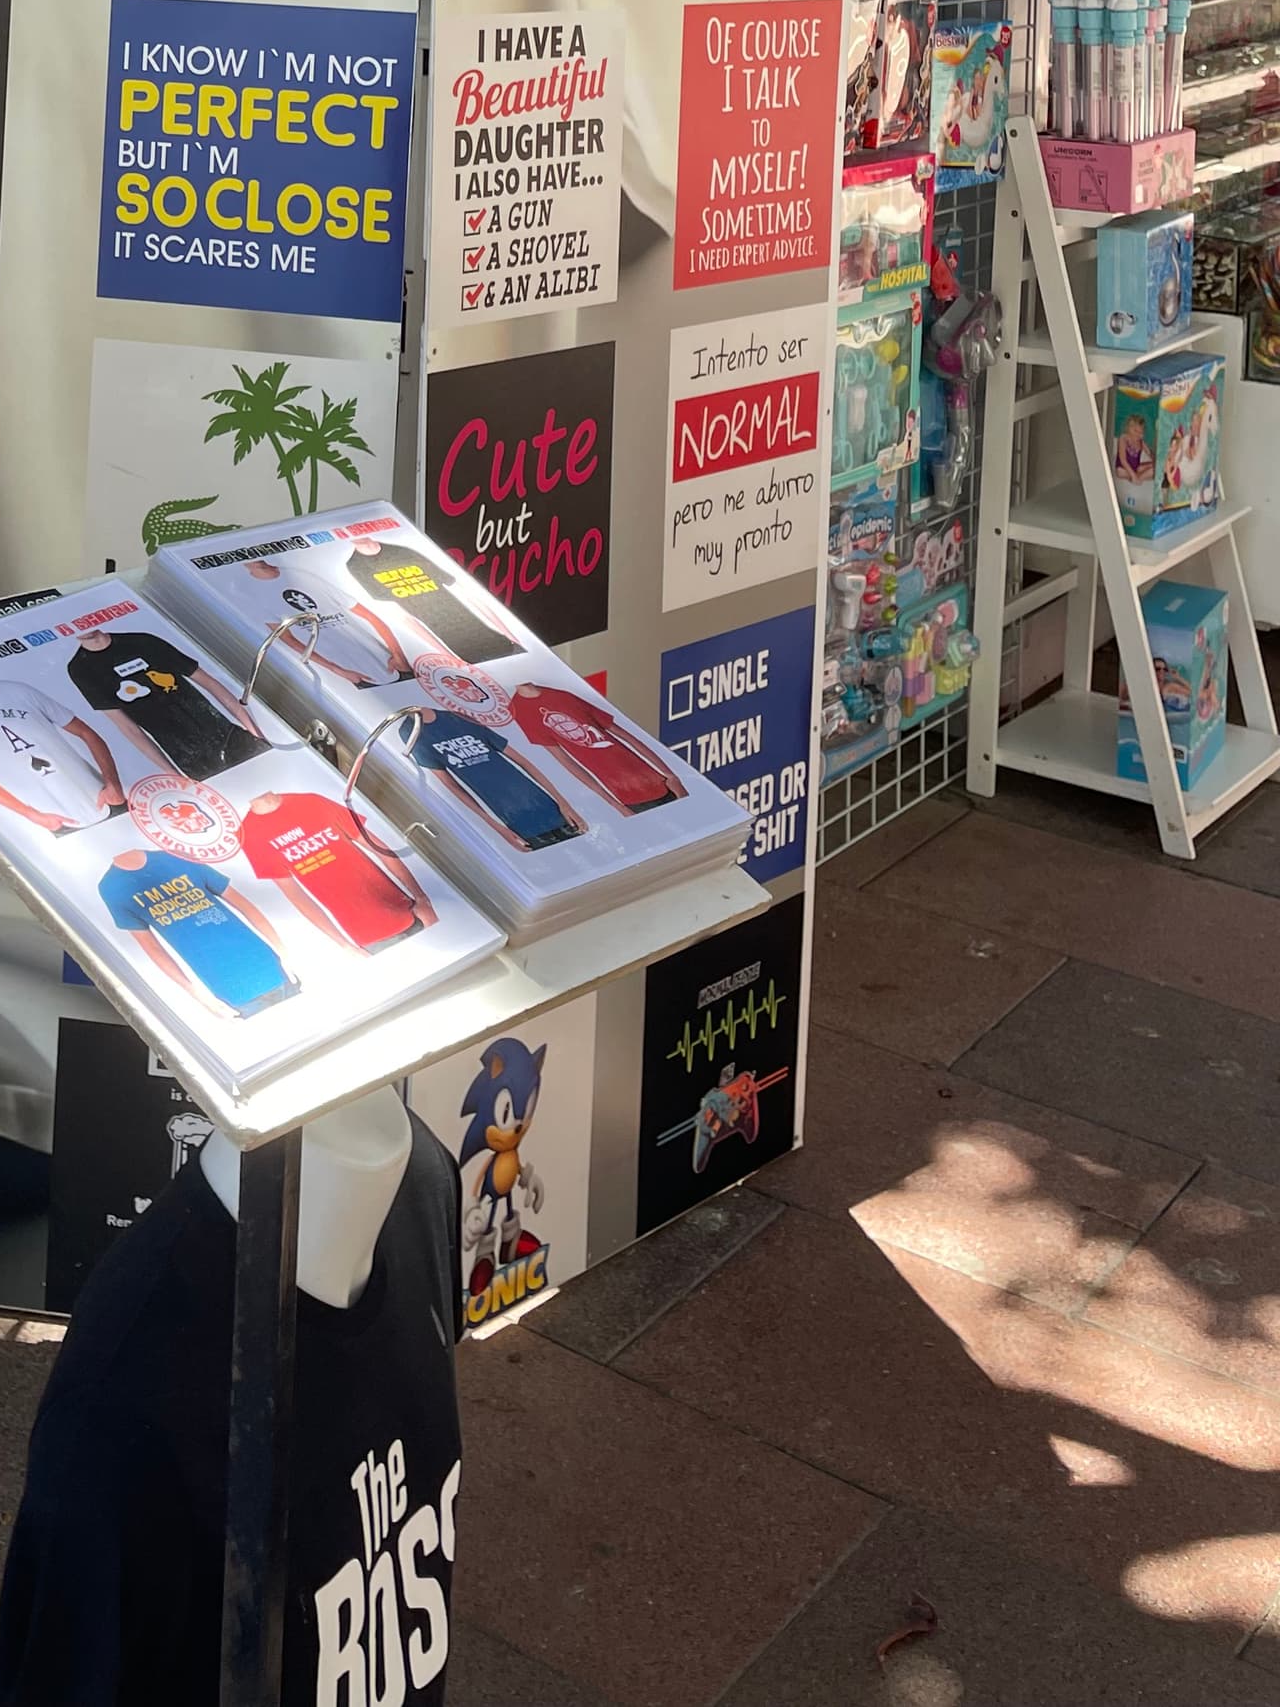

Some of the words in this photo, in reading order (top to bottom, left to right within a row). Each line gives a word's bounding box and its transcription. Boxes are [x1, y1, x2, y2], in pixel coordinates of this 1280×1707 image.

[452, 57, 608, 127] Beautiful
[119, 79, 399, 150] PERFECT
[751, 117, 771, 147] TO
[454, 118, 604, 168] DAUGHTER
[1053, 147, 1093, 156] UNICORN
[116, 172, 198, 226] SO
[204, 177, 393, 244] CLOSE
[487, 205, 502, 233] A
[508, 199, 553, 230] GUN
[114, 231, 136, 258] IT
[143, 233, 261, 269] SCARES
[271, 243, 317, 274] ME
[689, 248, 696, 274] I
[698, 243, 730, 272] NEED
[732, 240, 771, 267] EXPERT
[772, 234, 818, 263] ADVICE.
[879, 263, 928, 291] HOSPITAL
[679, 385, 811, 468] NORMAL
[438, 407, 598, 517] Cute
[476, 502, 533, 553] but
[851, 516, 893, 539] epidemic
[190, 536, 310, 570] EVERYTHING
[23, 629, 58, 646] ON
[71, 600, 139, 630] SHIRT
[697, 649, 769, 710] SINGLE
[0, 709, 28, 720] MY
[1, 725, 35, 753] A
[696, 715, 762, 774] TAKEN
[754, 805, 799, 858] SHIT
[148, 888, 205, 919] ADDICTED
[156, 916, 172, 926] TO
[351, 1439, 407, 1571] The
